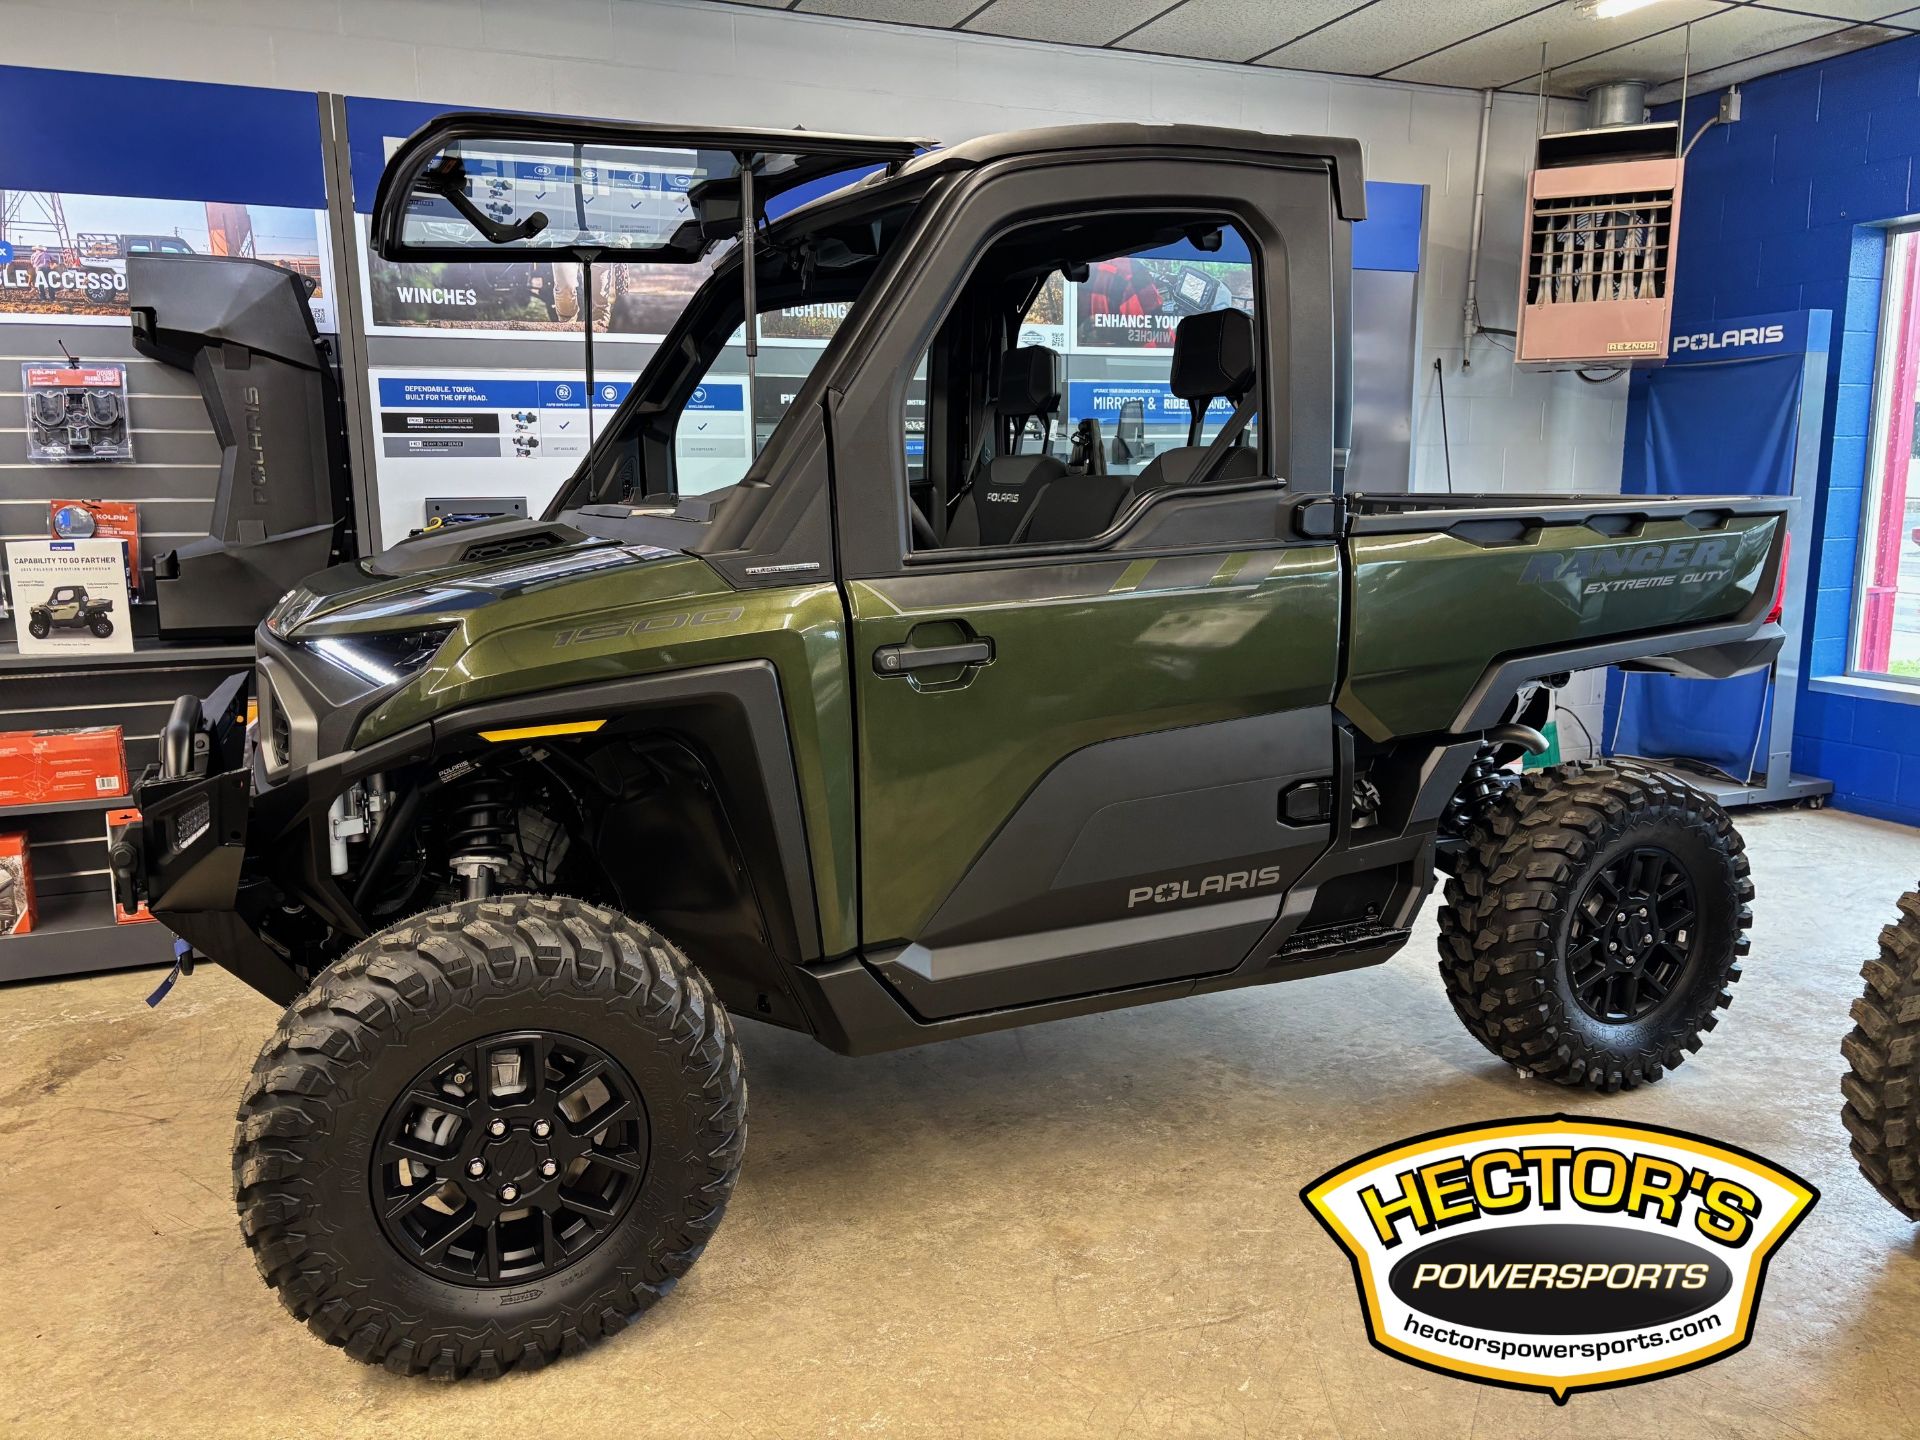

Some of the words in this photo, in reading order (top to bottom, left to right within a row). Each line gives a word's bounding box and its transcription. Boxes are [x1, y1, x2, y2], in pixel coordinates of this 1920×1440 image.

[0, 268, 29, 288] LE
[396, 286, 477, 306] WINCHES
[782, 302, 847, 319] LIGHTING
[1095, 313, 1152, 328] ENHANCE
[1609, 342, 1655, 350] REZNOR
[1673, 325, 1784, 353] POLARIS
[404, 385, 451, 393] DEPENDABLE.
[405, 393, 424, 401] BUILT
[1148, 397, 1156, 409] &
[244, 386, 267, 505] POLARIS
[986, 492, 1020, 503] POLARIS
[95, 513, 129, 522] KOLPIN
[14, 557, 56, 565] CAPABILITY
[81, 556, 116, 564] FARTHER
[1517, 538, 1730, 585] RANGER
[1582, 574, 1677, 595] EXTREME
[1679, 568, 1730, 585] DUTY
[552, 606, 745, 649] 1500
[1127, 865, 1281, 908] POLARIS
